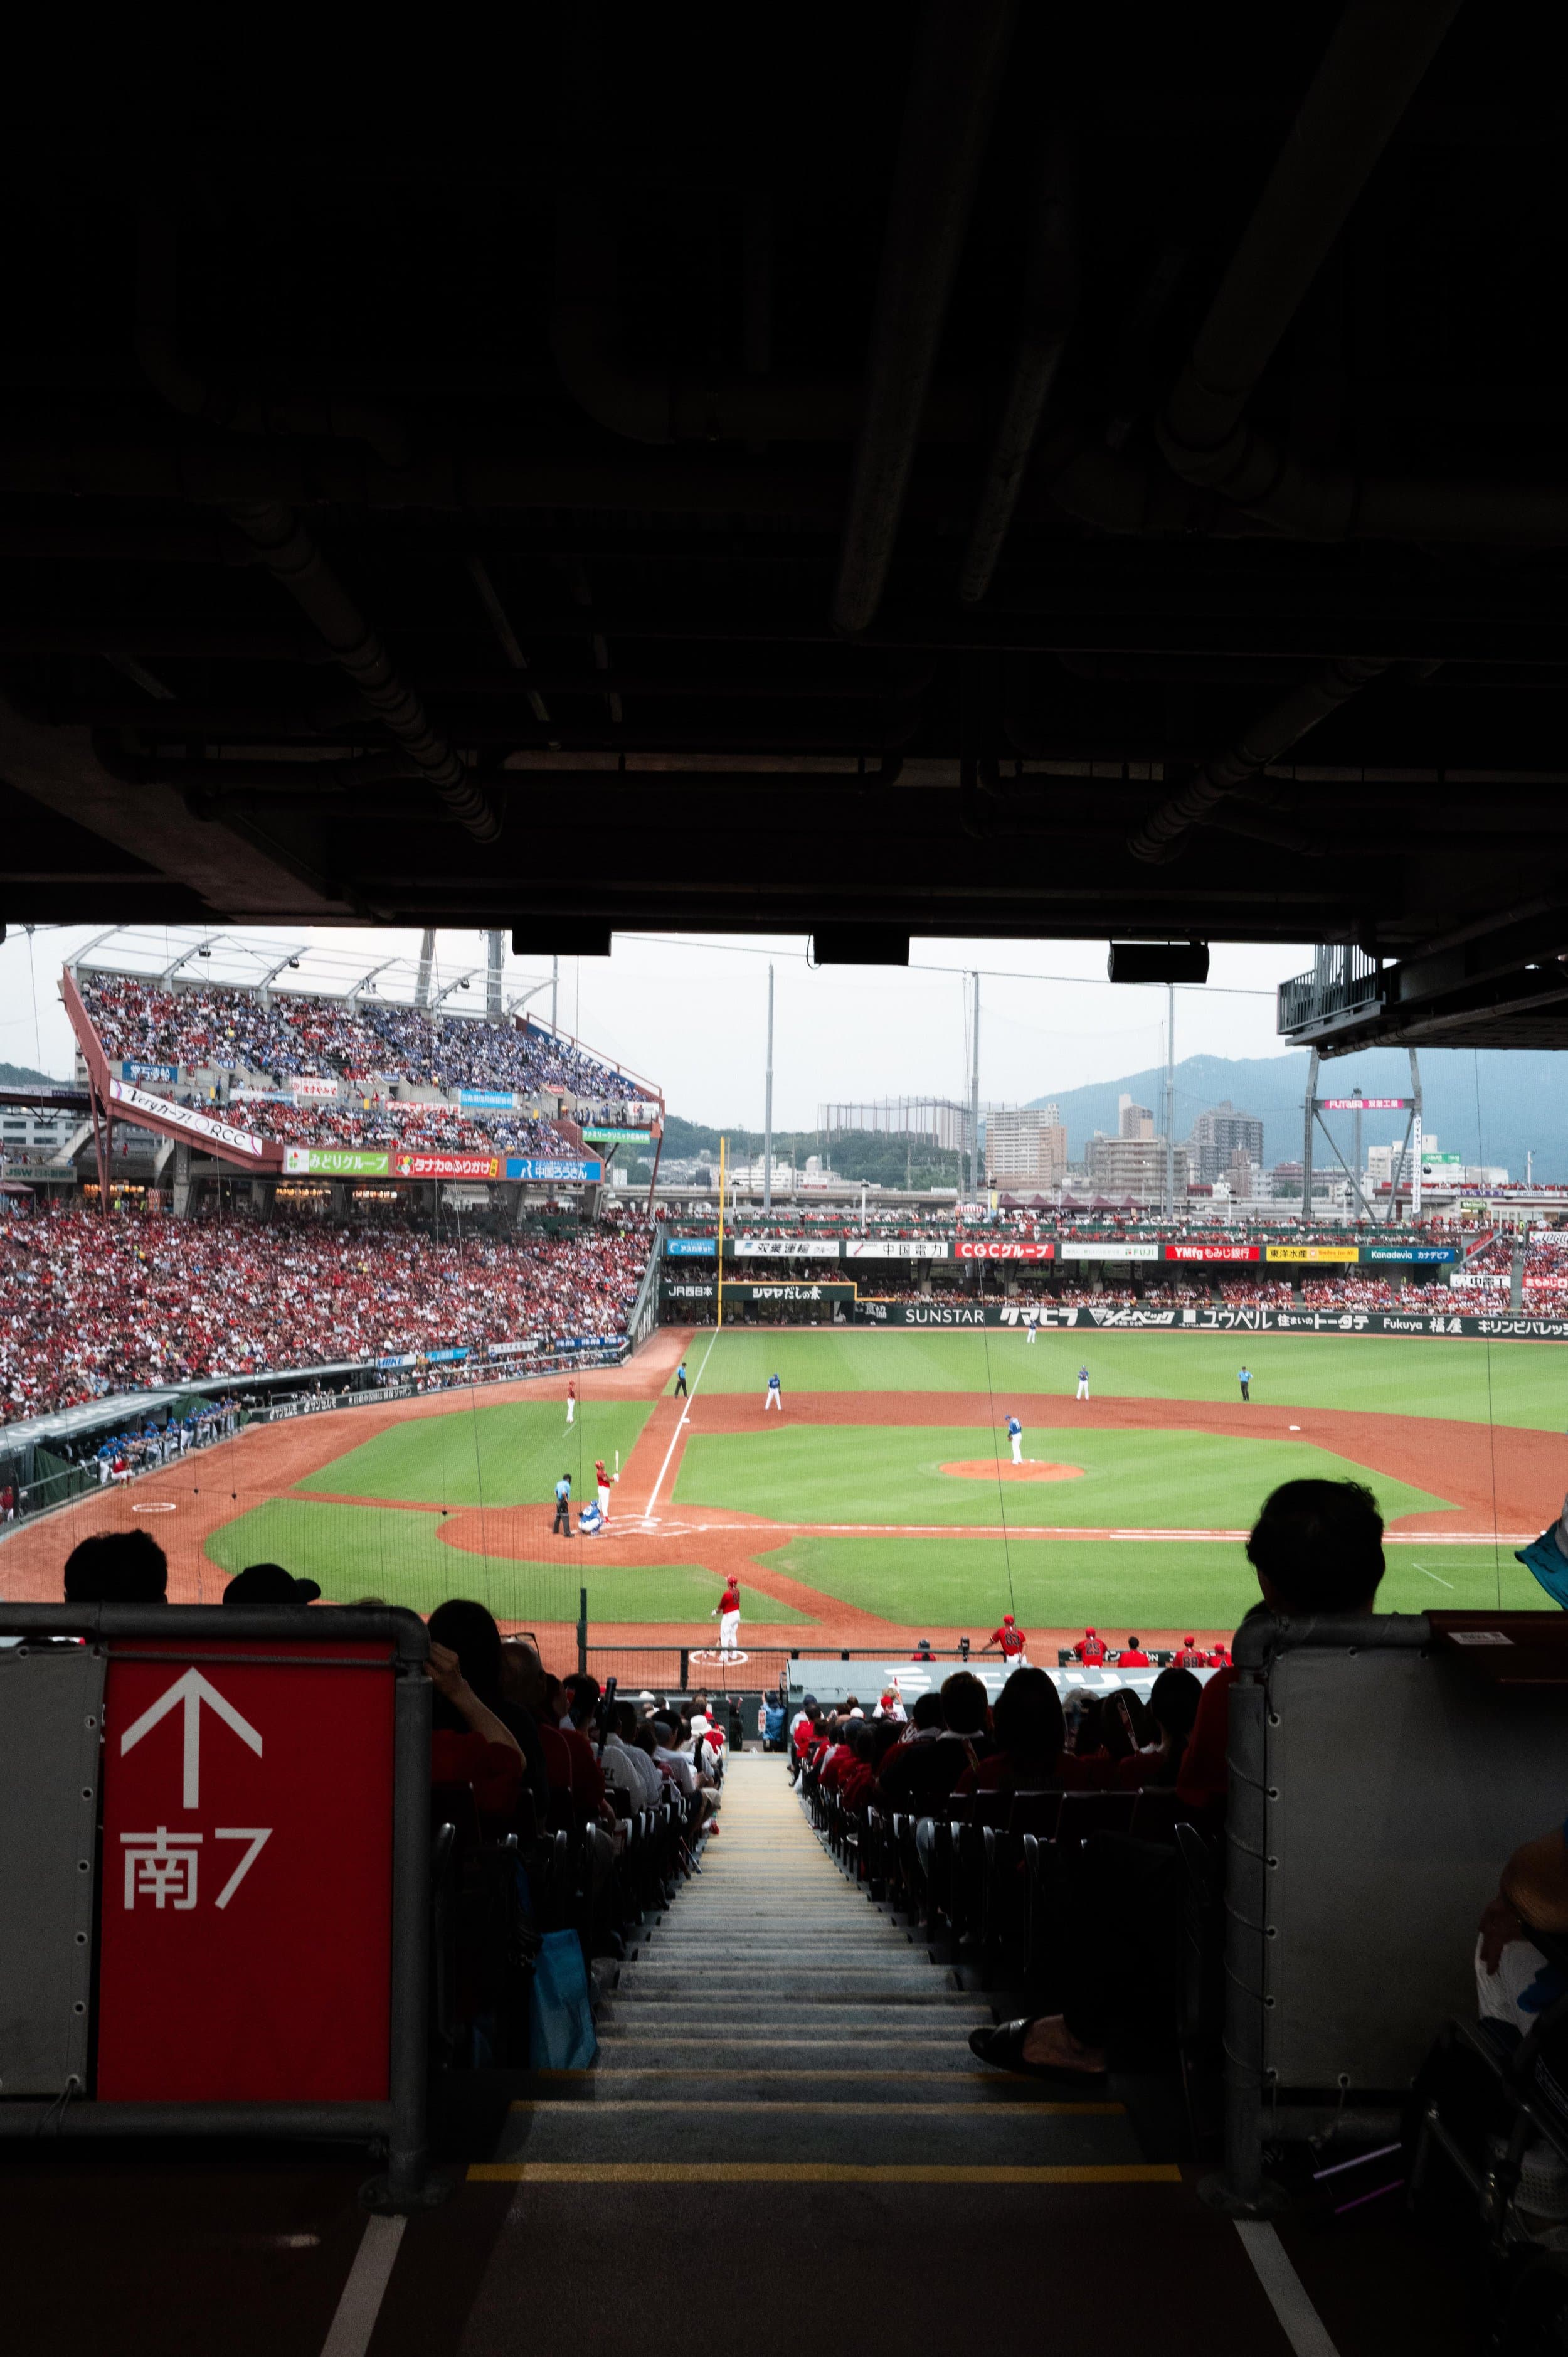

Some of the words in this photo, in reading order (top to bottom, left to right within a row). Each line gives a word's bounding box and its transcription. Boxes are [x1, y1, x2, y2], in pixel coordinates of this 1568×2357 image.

[211, 1125, 245, 1146] RCC
[309, 1154, 388, 1170] みどりグループ
[415, 1158, 489, 1174] タナカのふりかけ
[6, 1168, 31, 1177] JSW
[535, 1166, 587, 1179] 中国ろうきん
[758, 1243, 810, 1254] 双葉運輸
[883, 1243, 941, 1256] 中国電力
[961, 1243, 1048, 1258] CGCグループ
[1175, 1247, 1203, 1260] YMfg
[1204, 1248, 1249, 1258] もみじ銀行
[1270, 1249, 1308, 1258] 東洋水産
[1371, 1250, 1412, 1259] Kanadevia
[1417, 1251, 1449, 1259] カナデビア
[669, 1286, 712, 1297] JR西日本
[753, 1285, 822, 1299] シマヤだしの素
[906, 1309, 984, 1323] SUNSTAR
[1000, 1308, 1078, 1326] クマヒラ
[1103, 1309, 1175, 1326] ジーベック
[1200, 1311, 1273, 1329] ユウベル
[1384, 1318, 1422, 1331] Fukuya
[1429, 1317, 1463, 1334] 福屋
[120, 1825, 273, 1910] 南7
